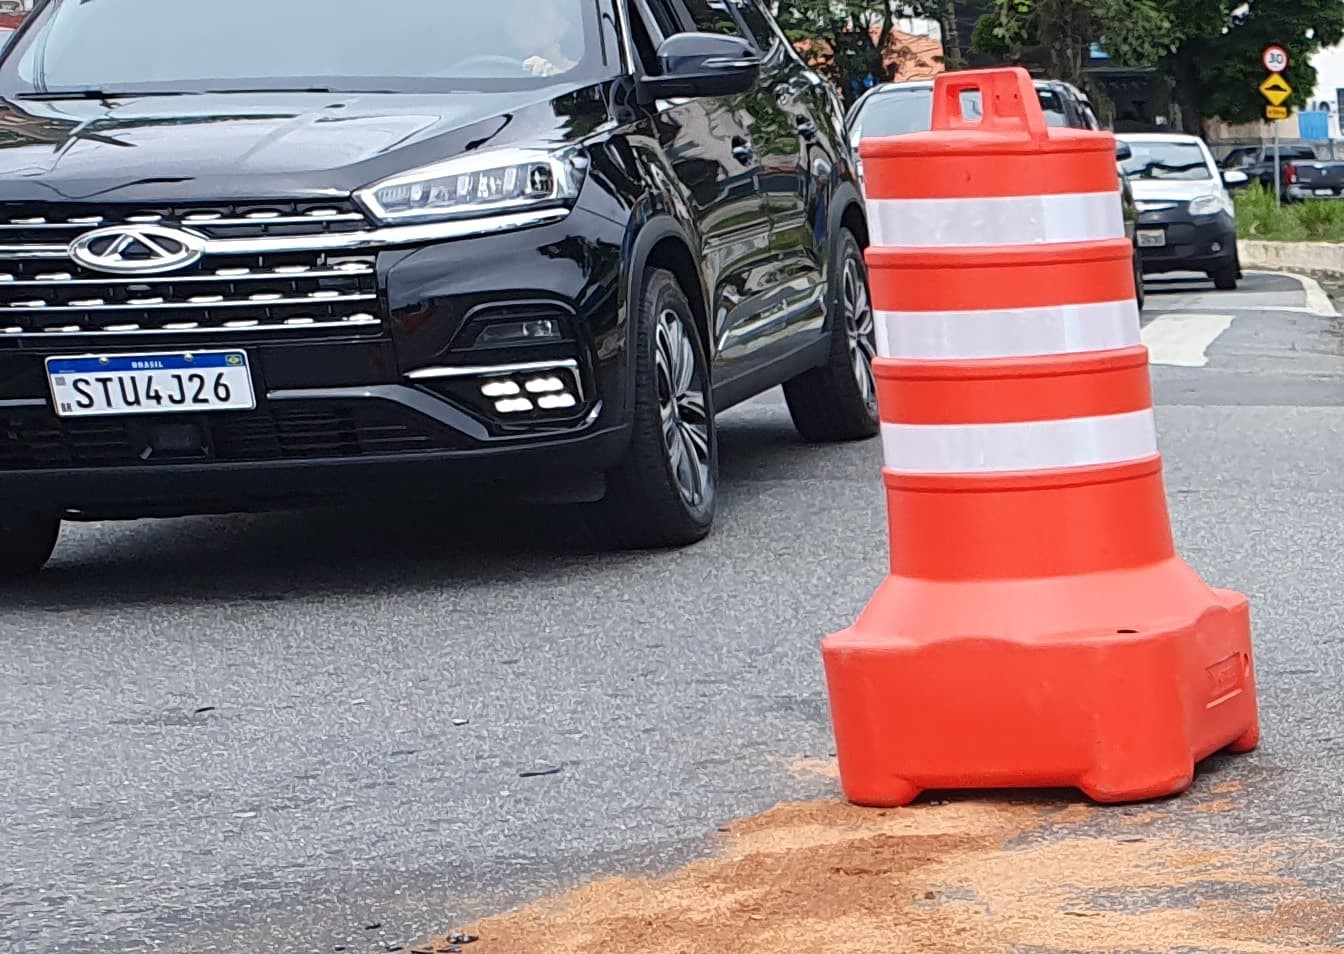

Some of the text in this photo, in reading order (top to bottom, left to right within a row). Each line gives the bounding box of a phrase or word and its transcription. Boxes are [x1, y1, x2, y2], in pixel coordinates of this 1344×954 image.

[1268, 53, 1284, 64] 30
[131, 360, 164, 369] BRASIL
[72, 372, 231, 408] STU4J26
